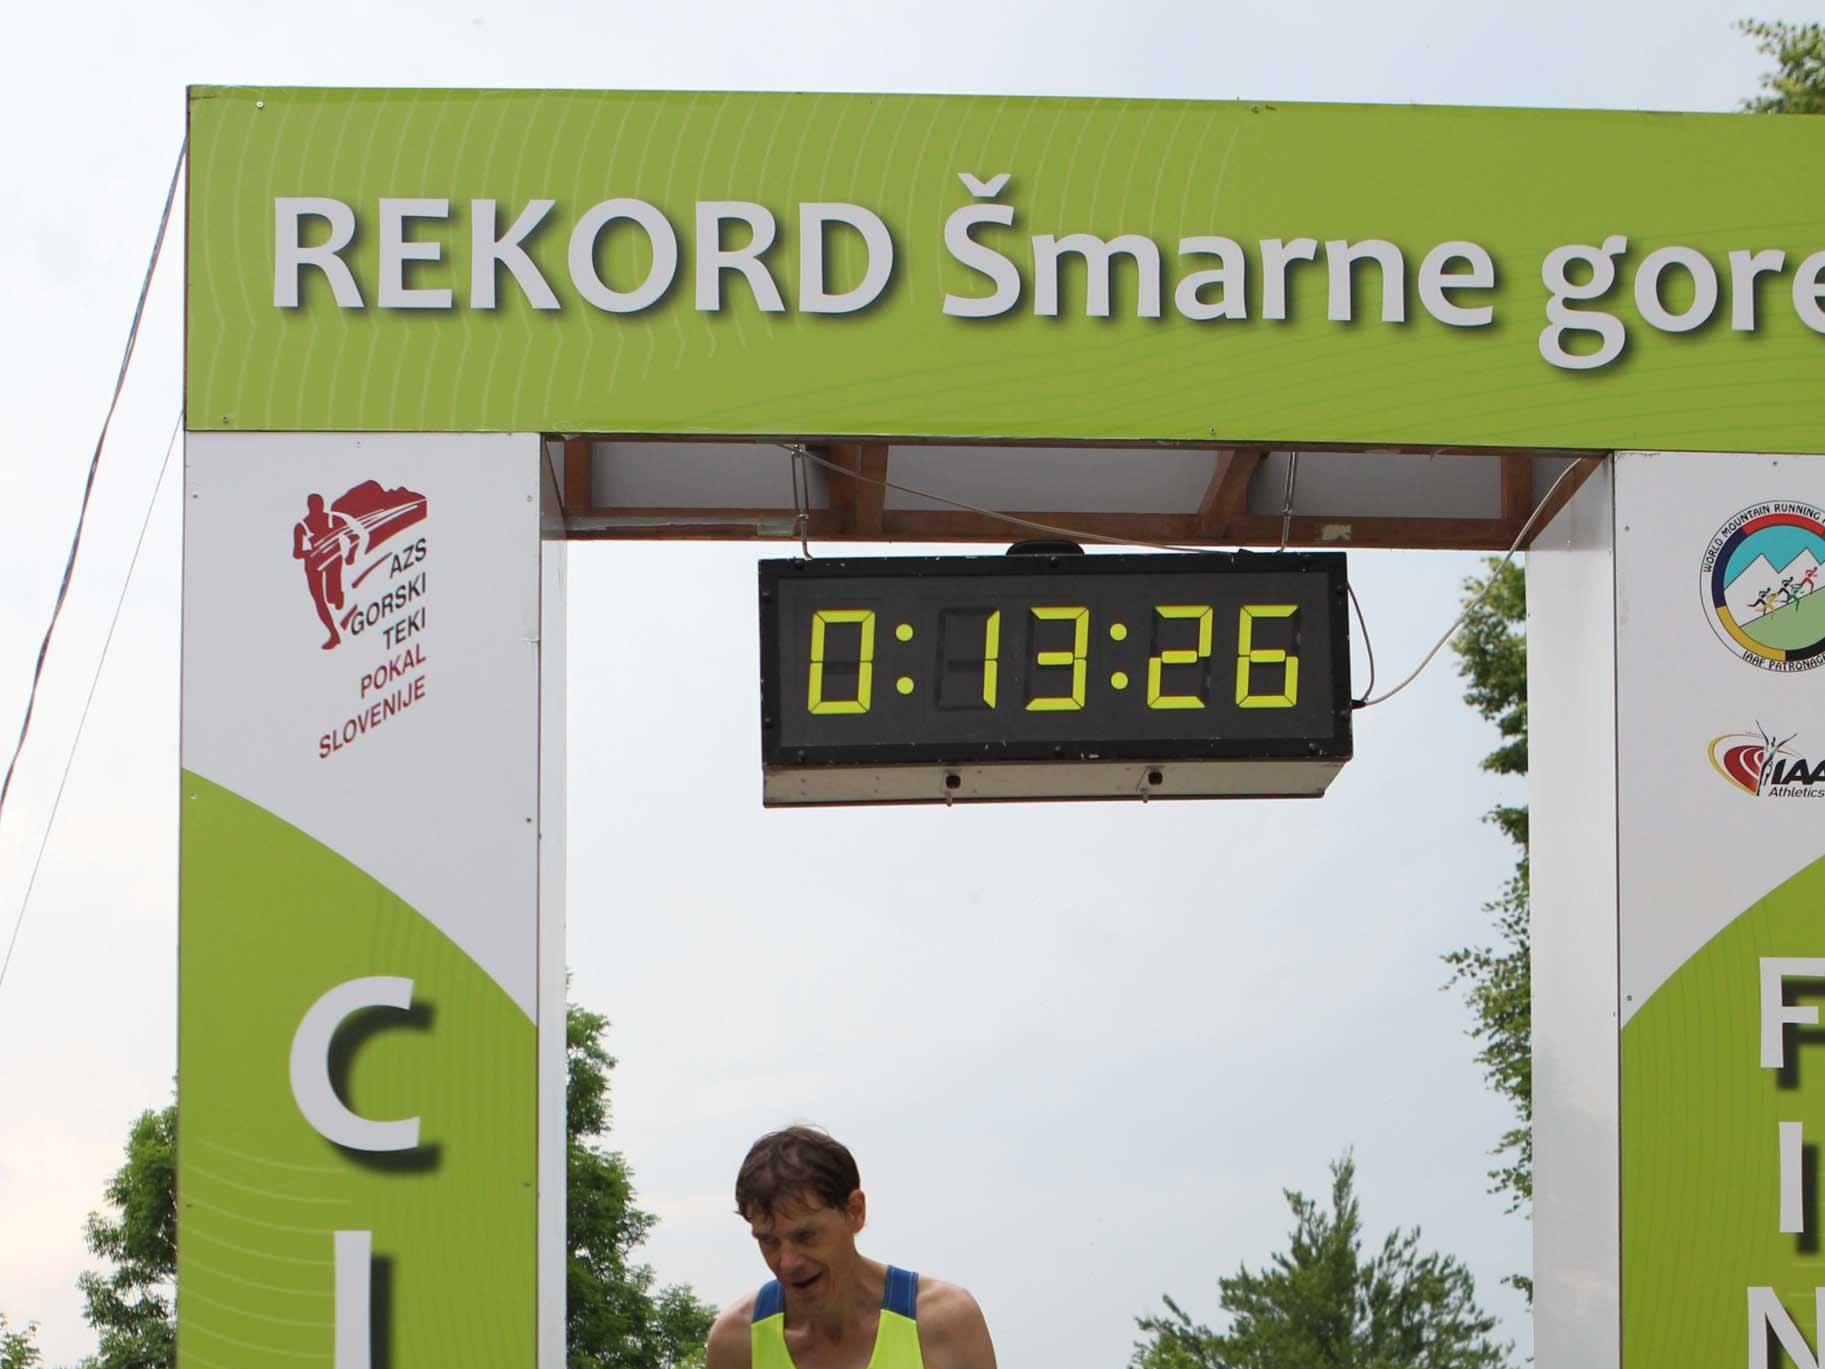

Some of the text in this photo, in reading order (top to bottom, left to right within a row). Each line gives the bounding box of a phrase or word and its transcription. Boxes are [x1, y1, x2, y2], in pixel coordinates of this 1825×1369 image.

[273, 196, 895, 313] REKORD
[942, 172, 1496, 328] Šmarne
[389, 537, 427, 579] AZS
[1703, 503, 1821, 573] WORLD MOUNTAIN RUNNING
[350, 571, 426, 636] GORSKI
[382, 606, 426, 650] TEKI
[360, 642, 426, 699] POKAL
[807, 604, 1299, 715] 0:13:26
[318, 675, 426, 759] SLOVENIJE
[1767, 785, 1825, 797] Athletics
